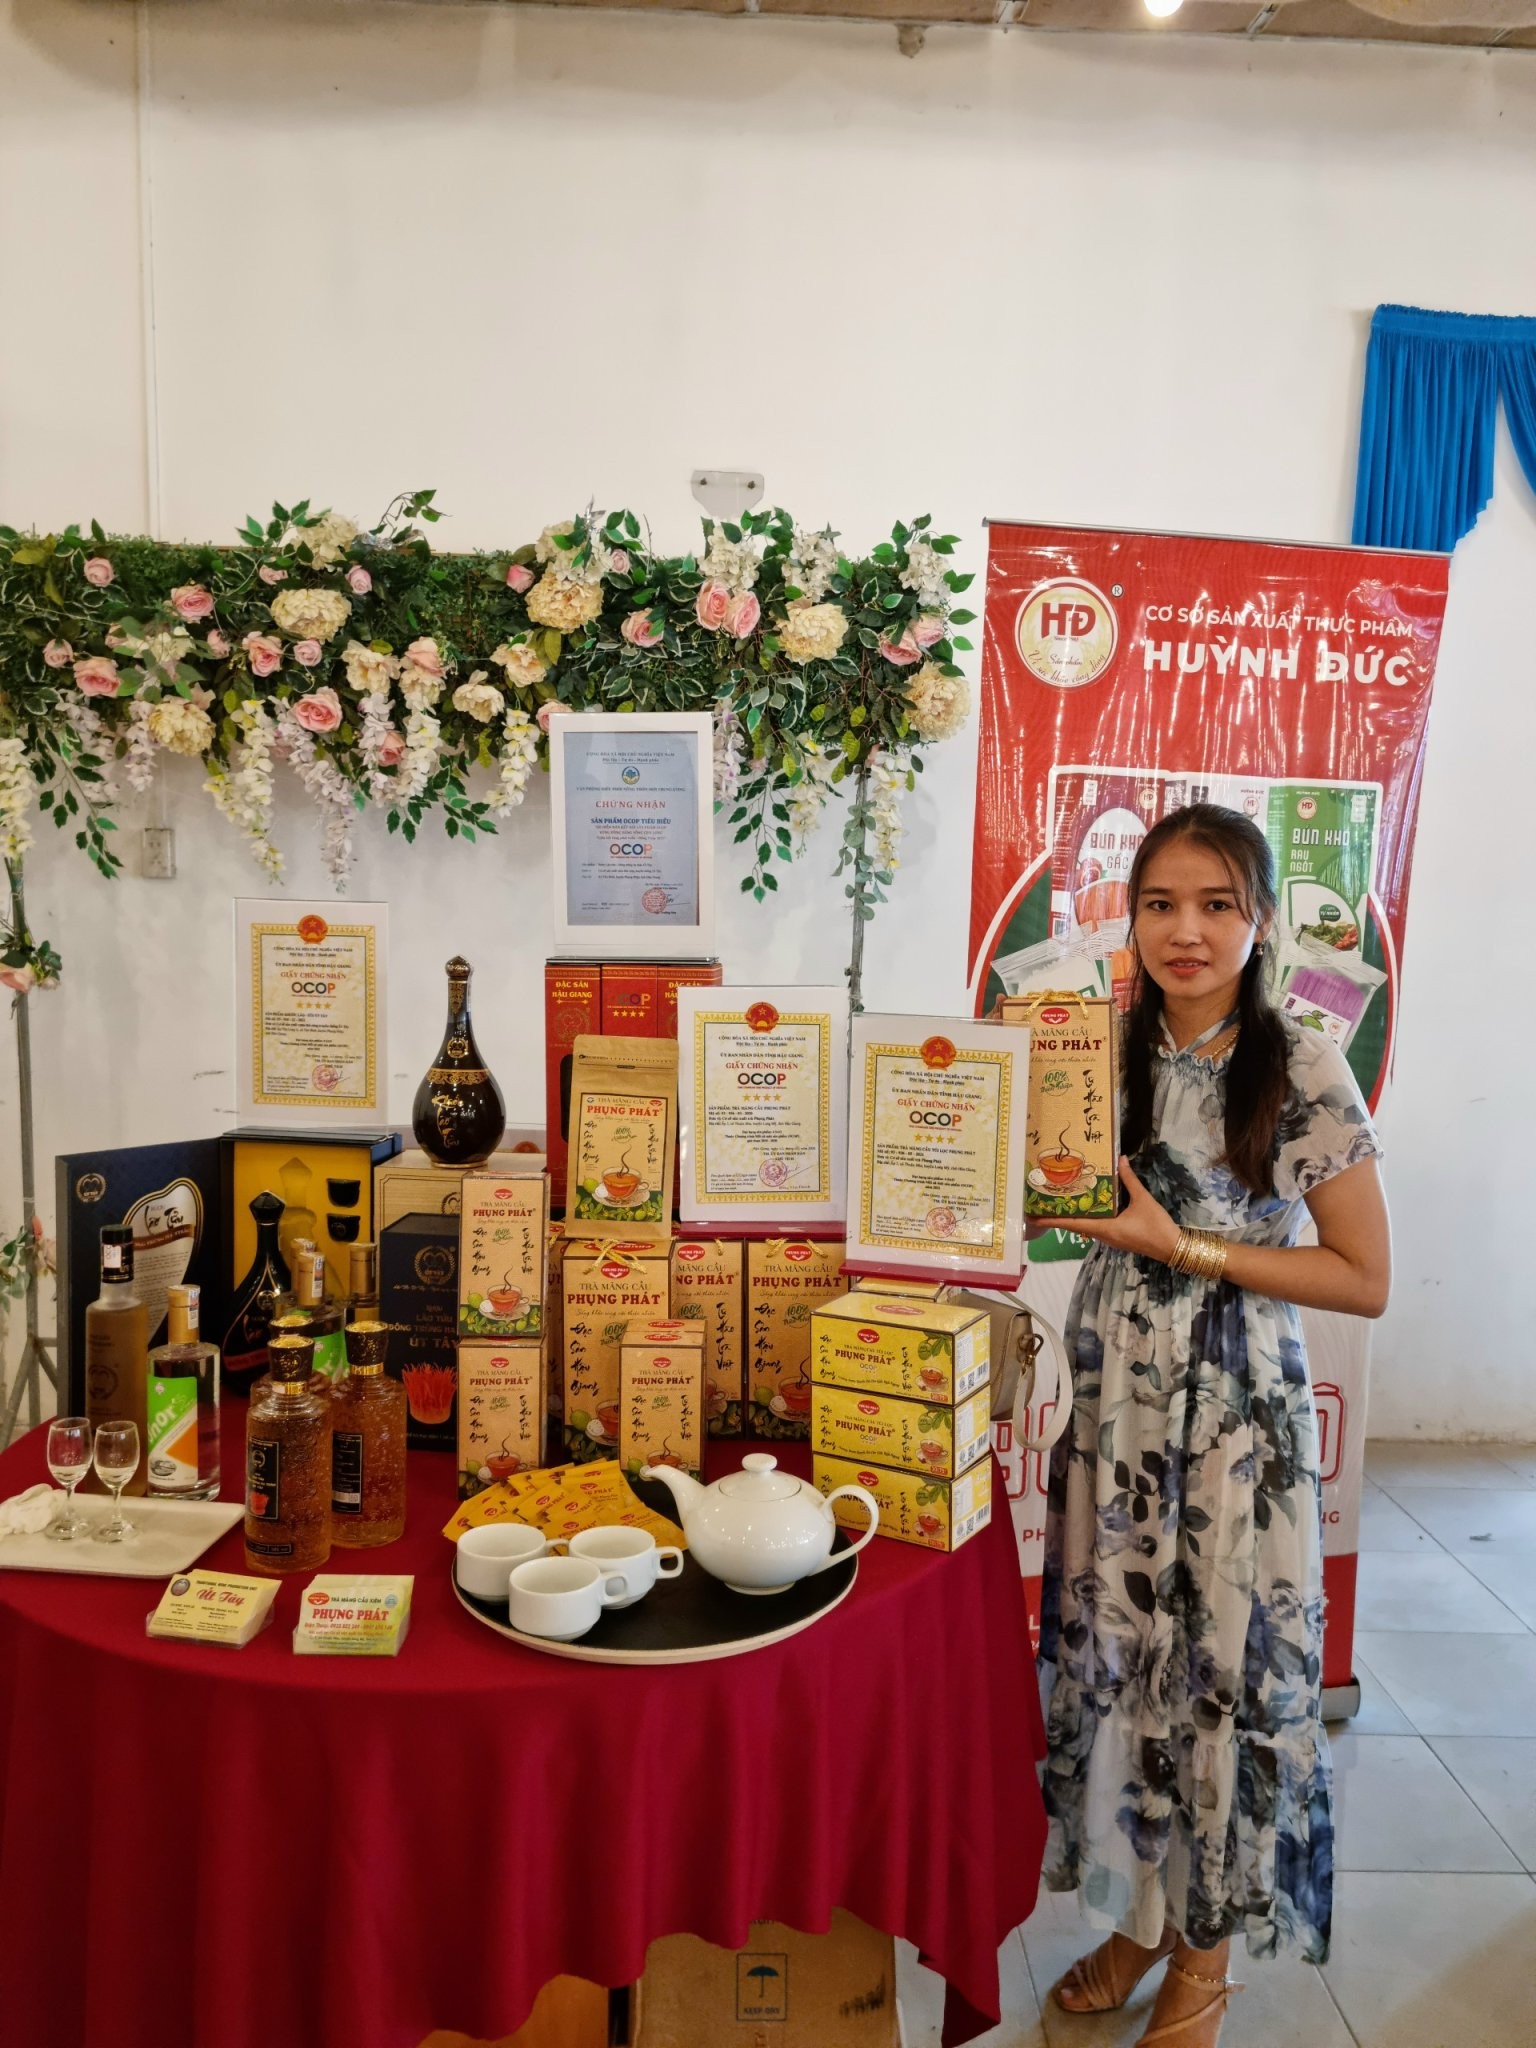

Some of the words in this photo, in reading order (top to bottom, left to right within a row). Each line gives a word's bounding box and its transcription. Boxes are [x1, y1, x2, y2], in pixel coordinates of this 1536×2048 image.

[1146, 605, 1173, 621] CƠ
[1177, 606, 1205, 624] SỞ
[1210, 605, 1246, 626] SẢN
[1251, 609, 1298, 630] XUẤT
[1304, 615, 1355, 636] THỰC
[1360, 616, 1412, 638] PHẨM
[1143, 636, 1299, 680] HUỲNH
[1317, 646, 1411, 686] ĐỨC
[595, 799, 633, 809] CHỨNG
[636, 799, 666, 810] NHẬN
[610, 843, 653, 856] OCOP
[1290, 849, 1310, 860] RAU
[291, 982, 336, 994] OCOP
[555, 981, 572, 989] ĐẶC
[573, 980, 589, 988] SẢN
[569, 991, 592, 999] GIANG
[1041, 1028, 1069, 1037] MÃNG
[1062, 1036, 1102, 1050] PHÁT
[726, 1061, 746, 1070] GIẤY
[747, 1061, 774, 1070] CHỨNG
[776, 1062, 799, 1070] NHẬN
[738, 1073, 786, 1085] OCOP
[587, 1105, 626, 1116] PHỤNG
[629, 1106, 660, 1117] PHÁT
[897, 1098, 918, 1107] GIẤY
[920, 1099, 950, 1110] CHỨNG
[951, 1102, 976, 1112] NHẬN
[909, 1111, 962, 1127] OCOP
[473, 1209, 505, 1219] PHỤNG
[507, 1208, 533, 1217] PHÁT
[764, 1263, 782, 1273] TRÀ
[783, 1264, 812, 1273] MÃNG
[698, 1273, 734, 1285] PHÁT
[753, 1276, 801, 1291] PHỤNG
[804, 1274, 842, 1288] PHÁT
[579, 1282, 599, 1290] TRÀ
[601, 1281, 629, 1290] MÃNG
[567, 1293, 619, 1308] PHỤNG
[622, 1290, 661, 1305] PHÁT
[389, 1322, 412, 1332] ĐÔNG
[835, 1348, 865, 1361] PHỤNG
[868, 1354, 892, 1366] PHÁT
[469, 1378, 502, 1387] PHỤNG
[504, 1376, 530, 1386] PHÁT
[632, 1377, 664, 1387] PHỤNG
[666, 1375, 692, 1385] PHÁT
[835, 1420, 866, 1432] PHỤNG
[868, 1426, 892, 1437] PHÁT
[312, 1608, 354, 1622] PHỤNG
[356, 1607, 390, 1621] PHÁT
